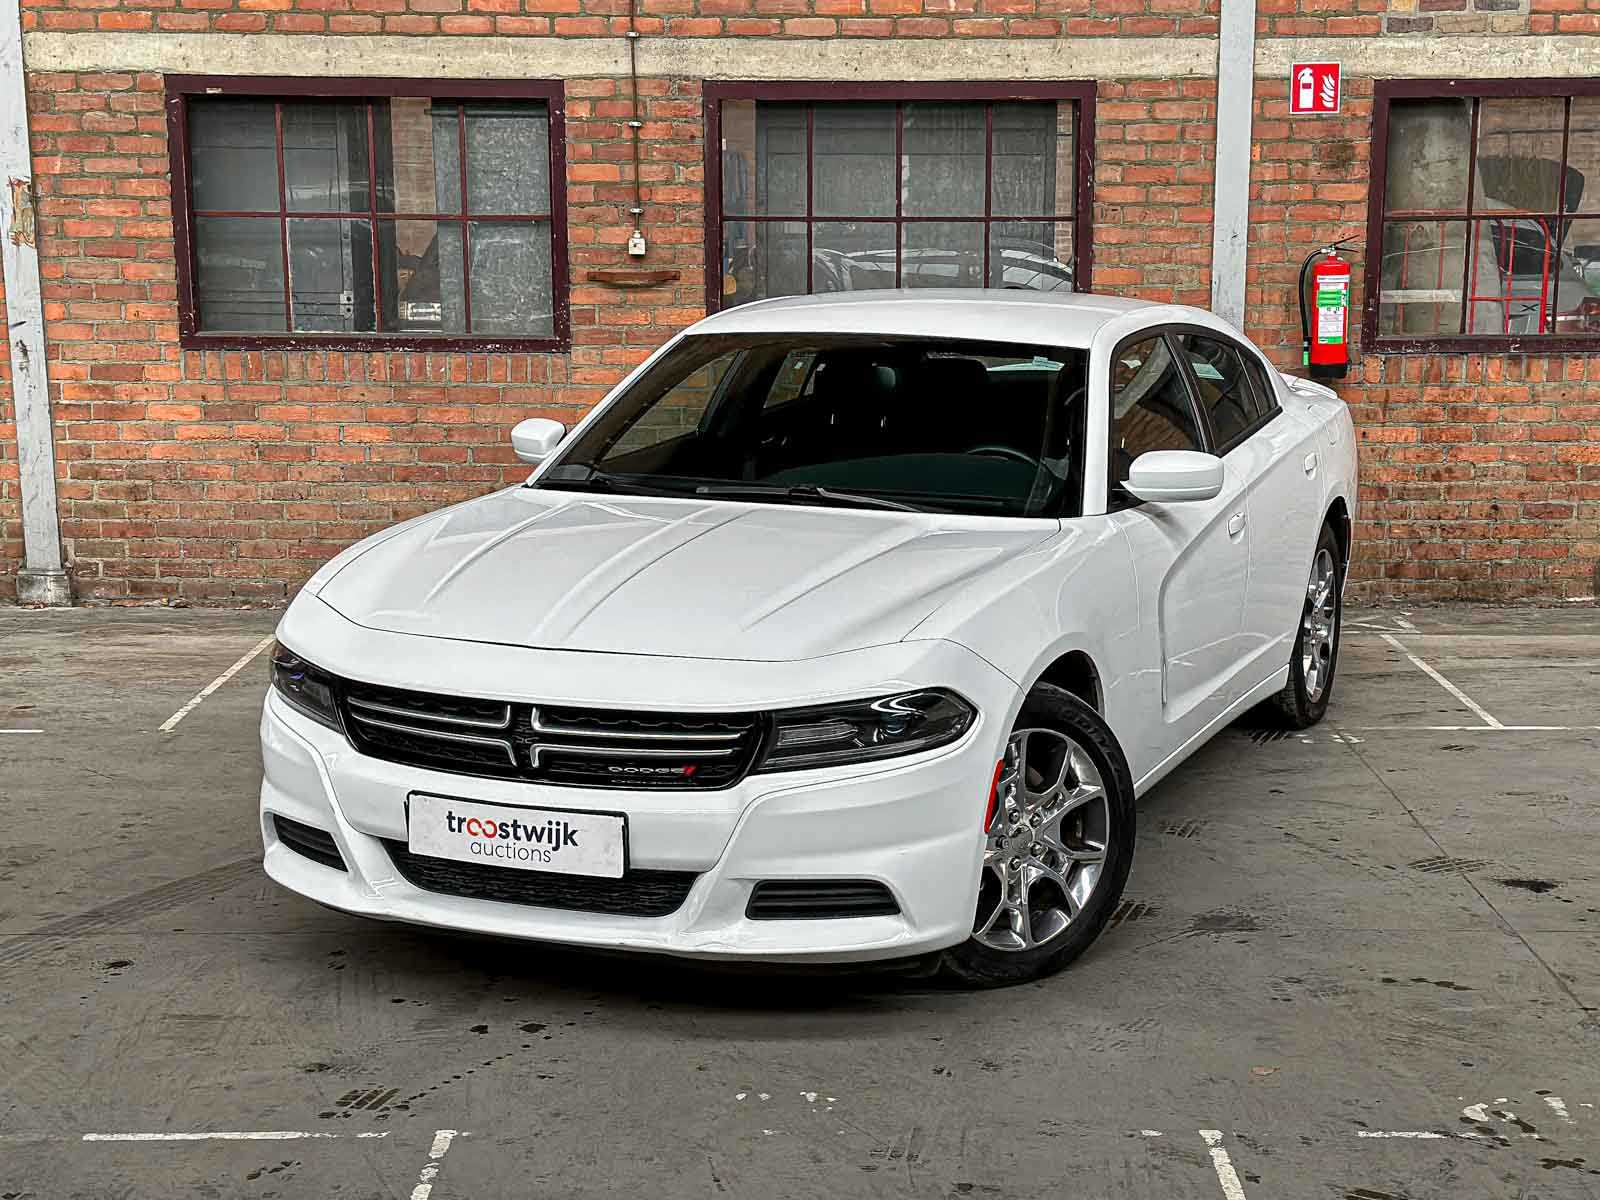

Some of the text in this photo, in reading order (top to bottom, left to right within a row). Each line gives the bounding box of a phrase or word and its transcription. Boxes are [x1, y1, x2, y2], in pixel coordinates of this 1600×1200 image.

[608, 766, 685, 774] DODGE
[446, 811, 579, 851] troostwijk
[470, 841, 552, 863] auctions
